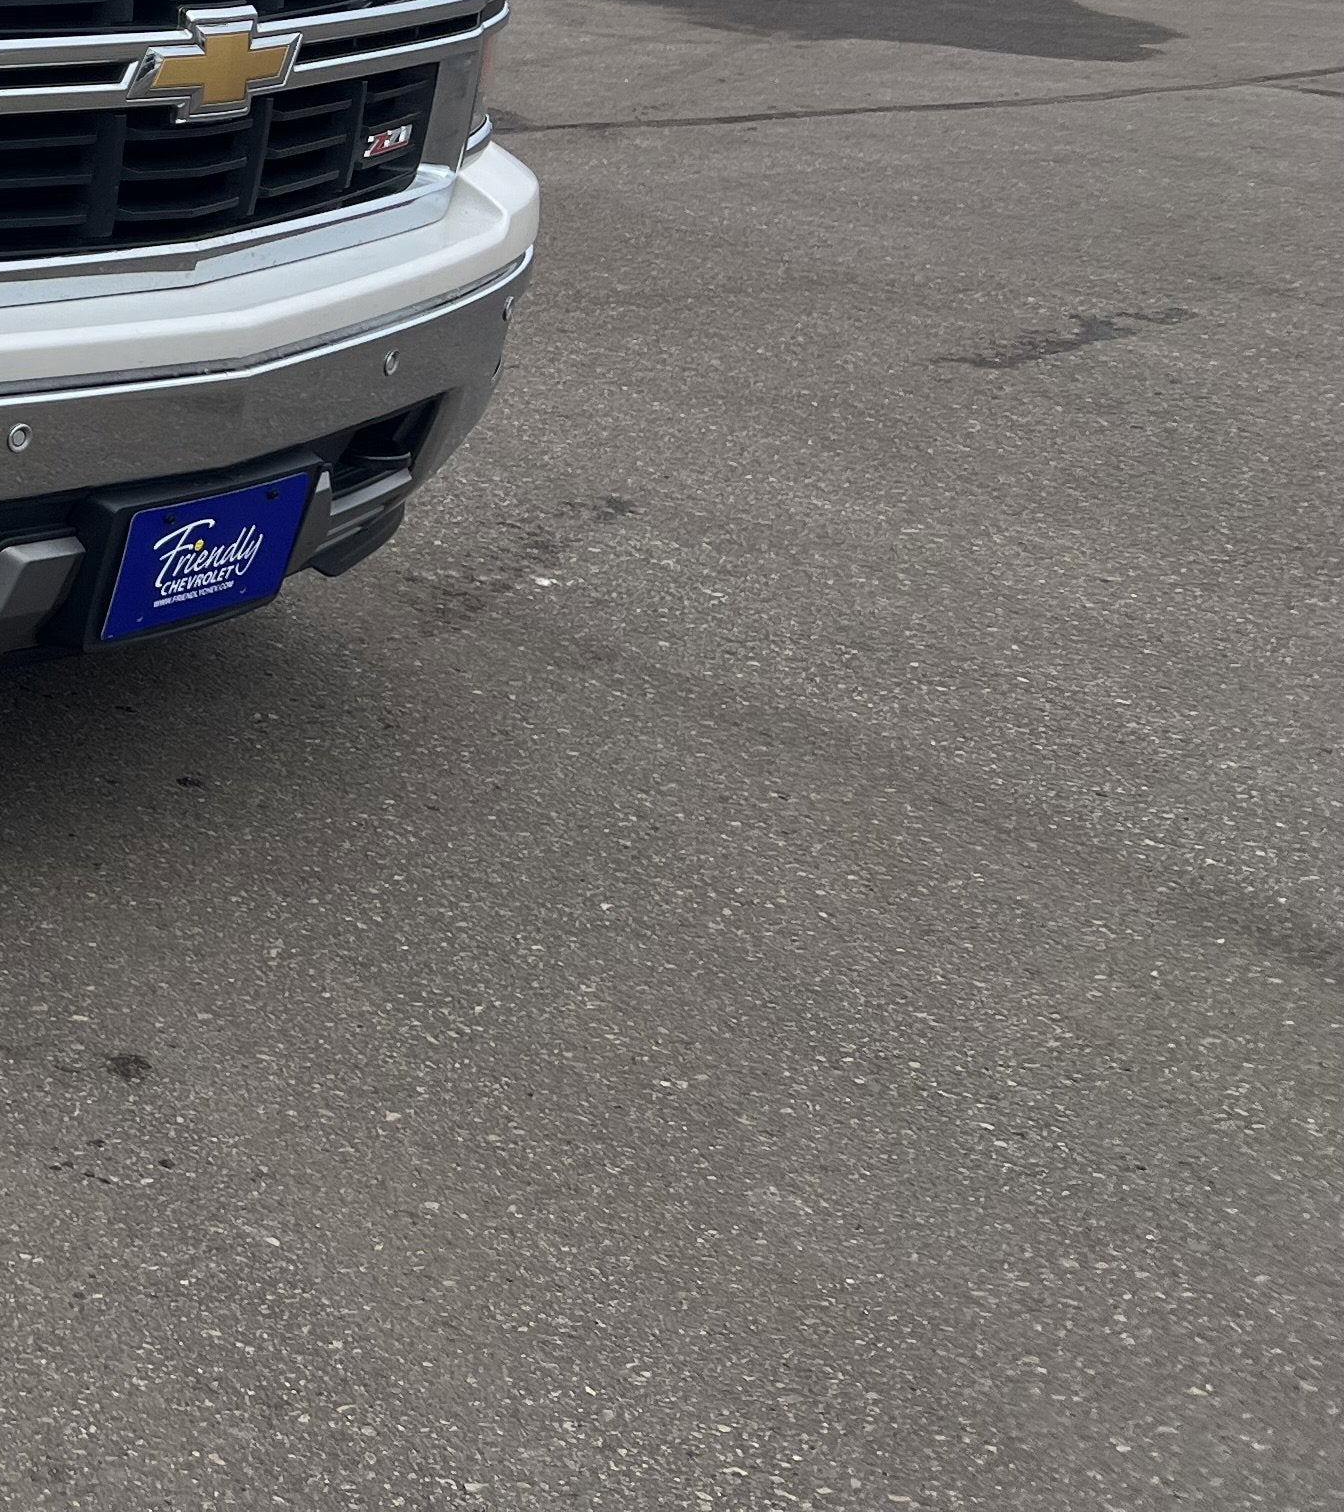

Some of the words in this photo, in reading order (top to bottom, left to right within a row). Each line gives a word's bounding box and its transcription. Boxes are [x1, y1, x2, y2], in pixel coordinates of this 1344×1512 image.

[363, 123, 413, 158] Z71
[153, 518, 264, 588] Friendly
[160, 565, 235, 596] CHEVROLET
